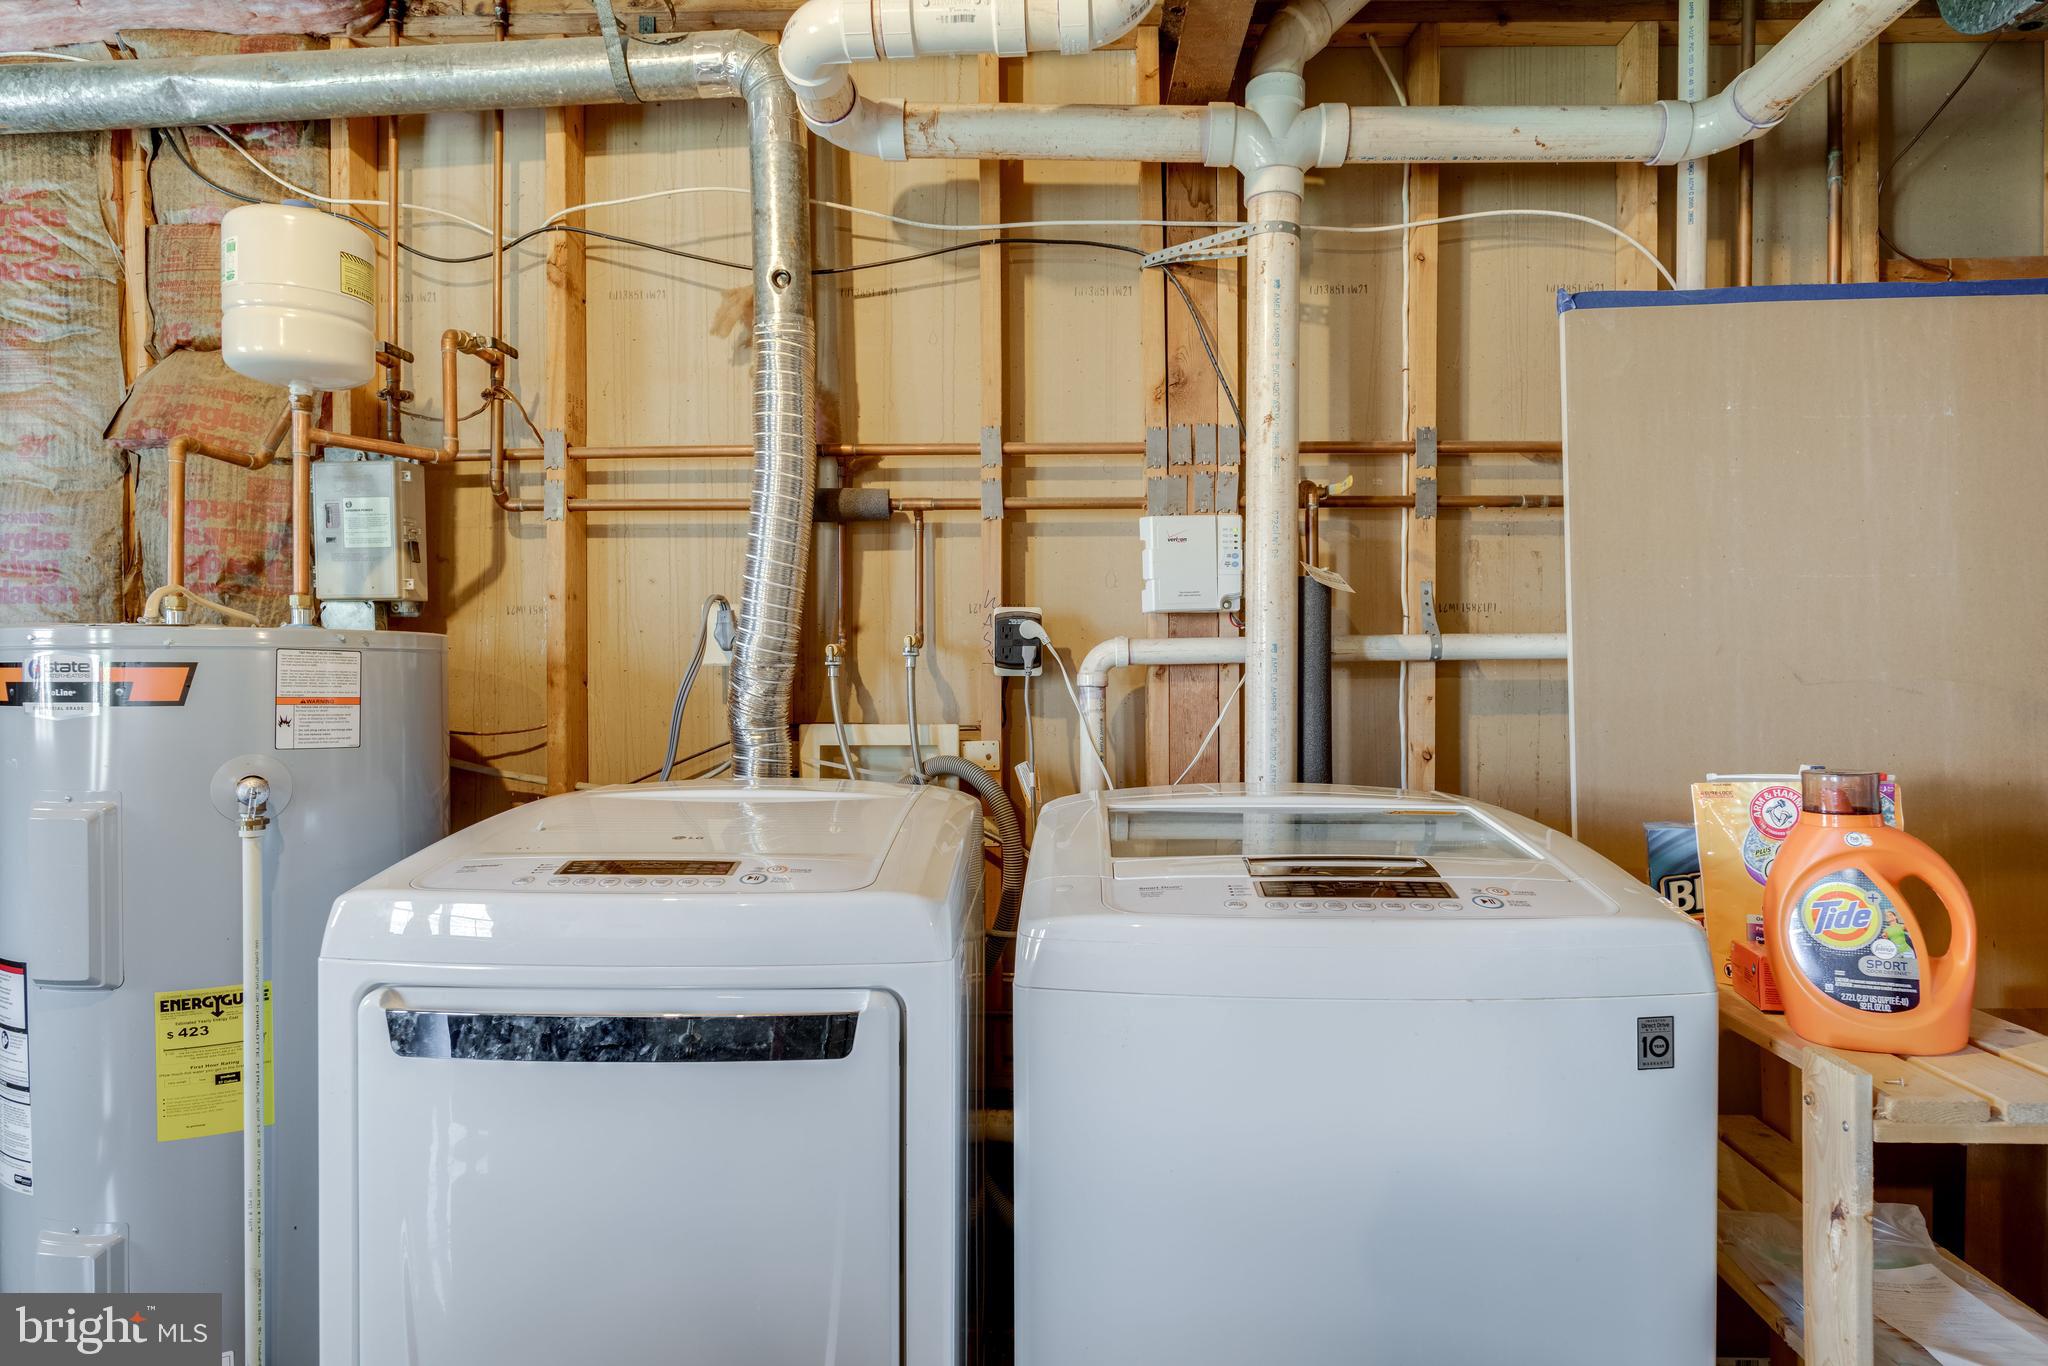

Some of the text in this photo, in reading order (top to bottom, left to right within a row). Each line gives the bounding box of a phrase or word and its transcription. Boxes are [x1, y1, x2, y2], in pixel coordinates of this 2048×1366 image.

[1773, 789, 1802, 807] HAMM
[1755, 847, 1772, 856] PLUS
[1812, 899, 1872, 935] Tide
[1866, 960, 1908, 971] SPORT
[160, 988, 270, 1018] ENERGYGUE
[166, 1025, 210, 1040] $ 423
[1642, 1035, 1669, 1058] 10
